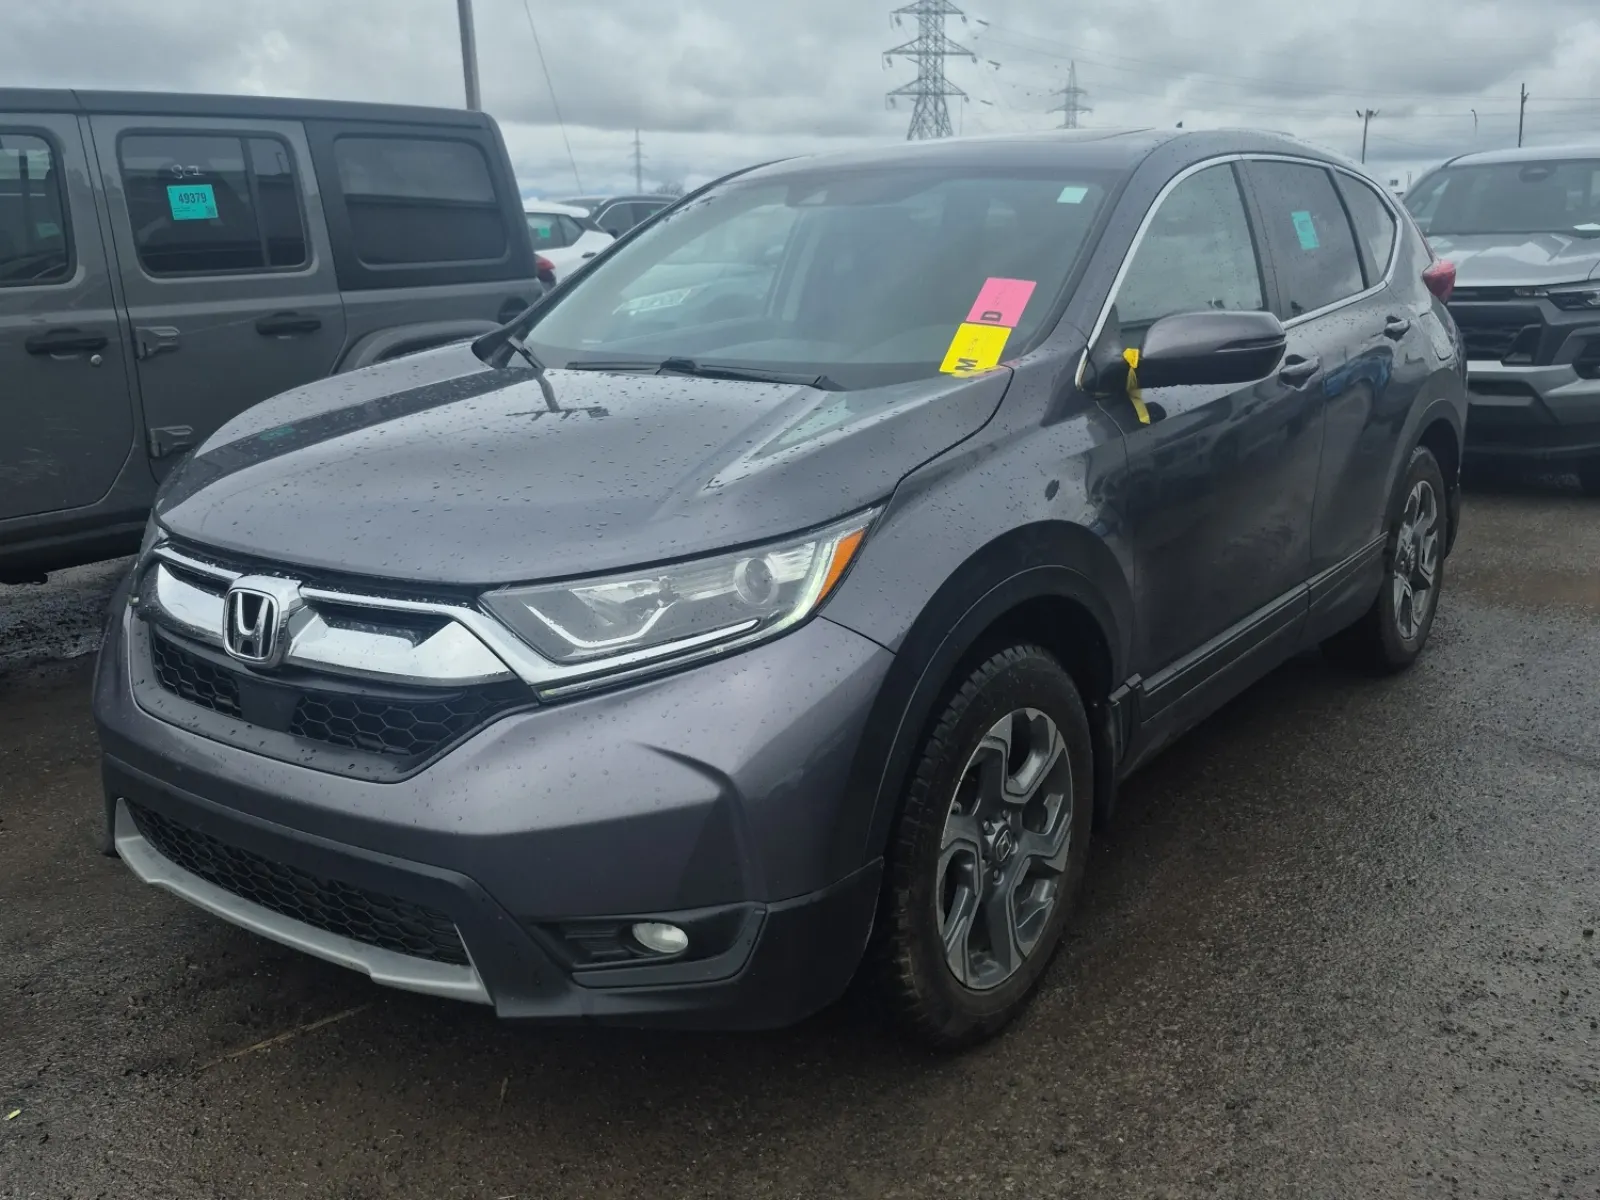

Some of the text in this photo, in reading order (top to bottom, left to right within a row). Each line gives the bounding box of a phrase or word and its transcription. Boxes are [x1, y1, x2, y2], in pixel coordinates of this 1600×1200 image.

[178, 192, 207, 204] 49379
[980, 311, 1003, 322] D
[954, 358, 979, 371] M
